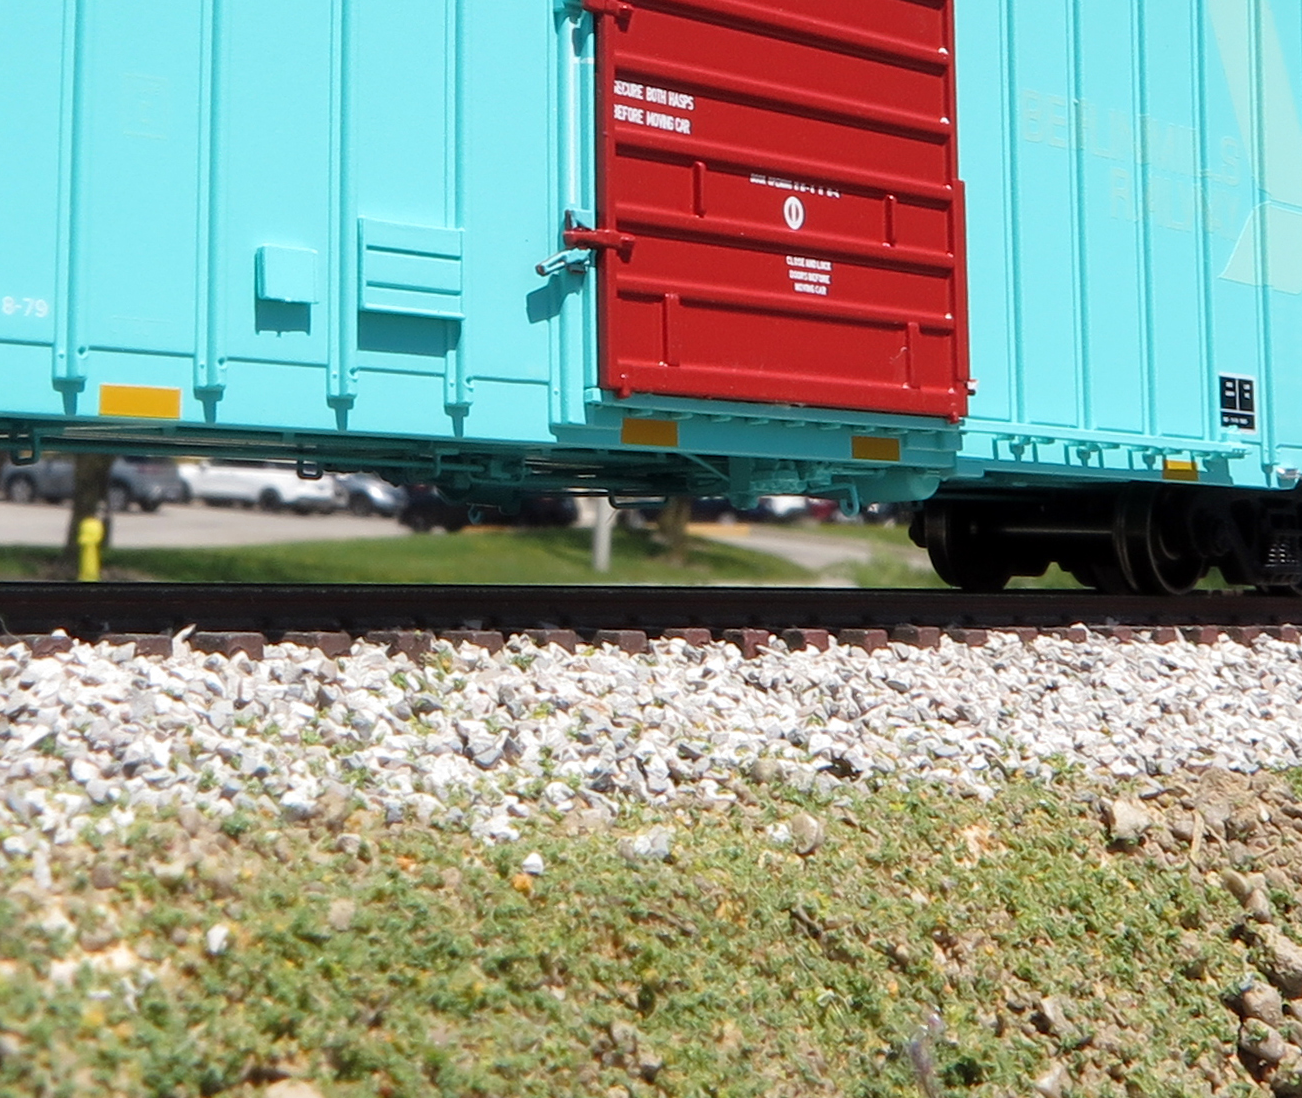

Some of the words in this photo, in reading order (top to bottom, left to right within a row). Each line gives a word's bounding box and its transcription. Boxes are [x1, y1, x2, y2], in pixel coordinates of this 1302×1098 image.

[645, 86, 667, 105] BOTH
[668, 90, 695, 111] HASPS
[675, 117, 692, 135] CAR
